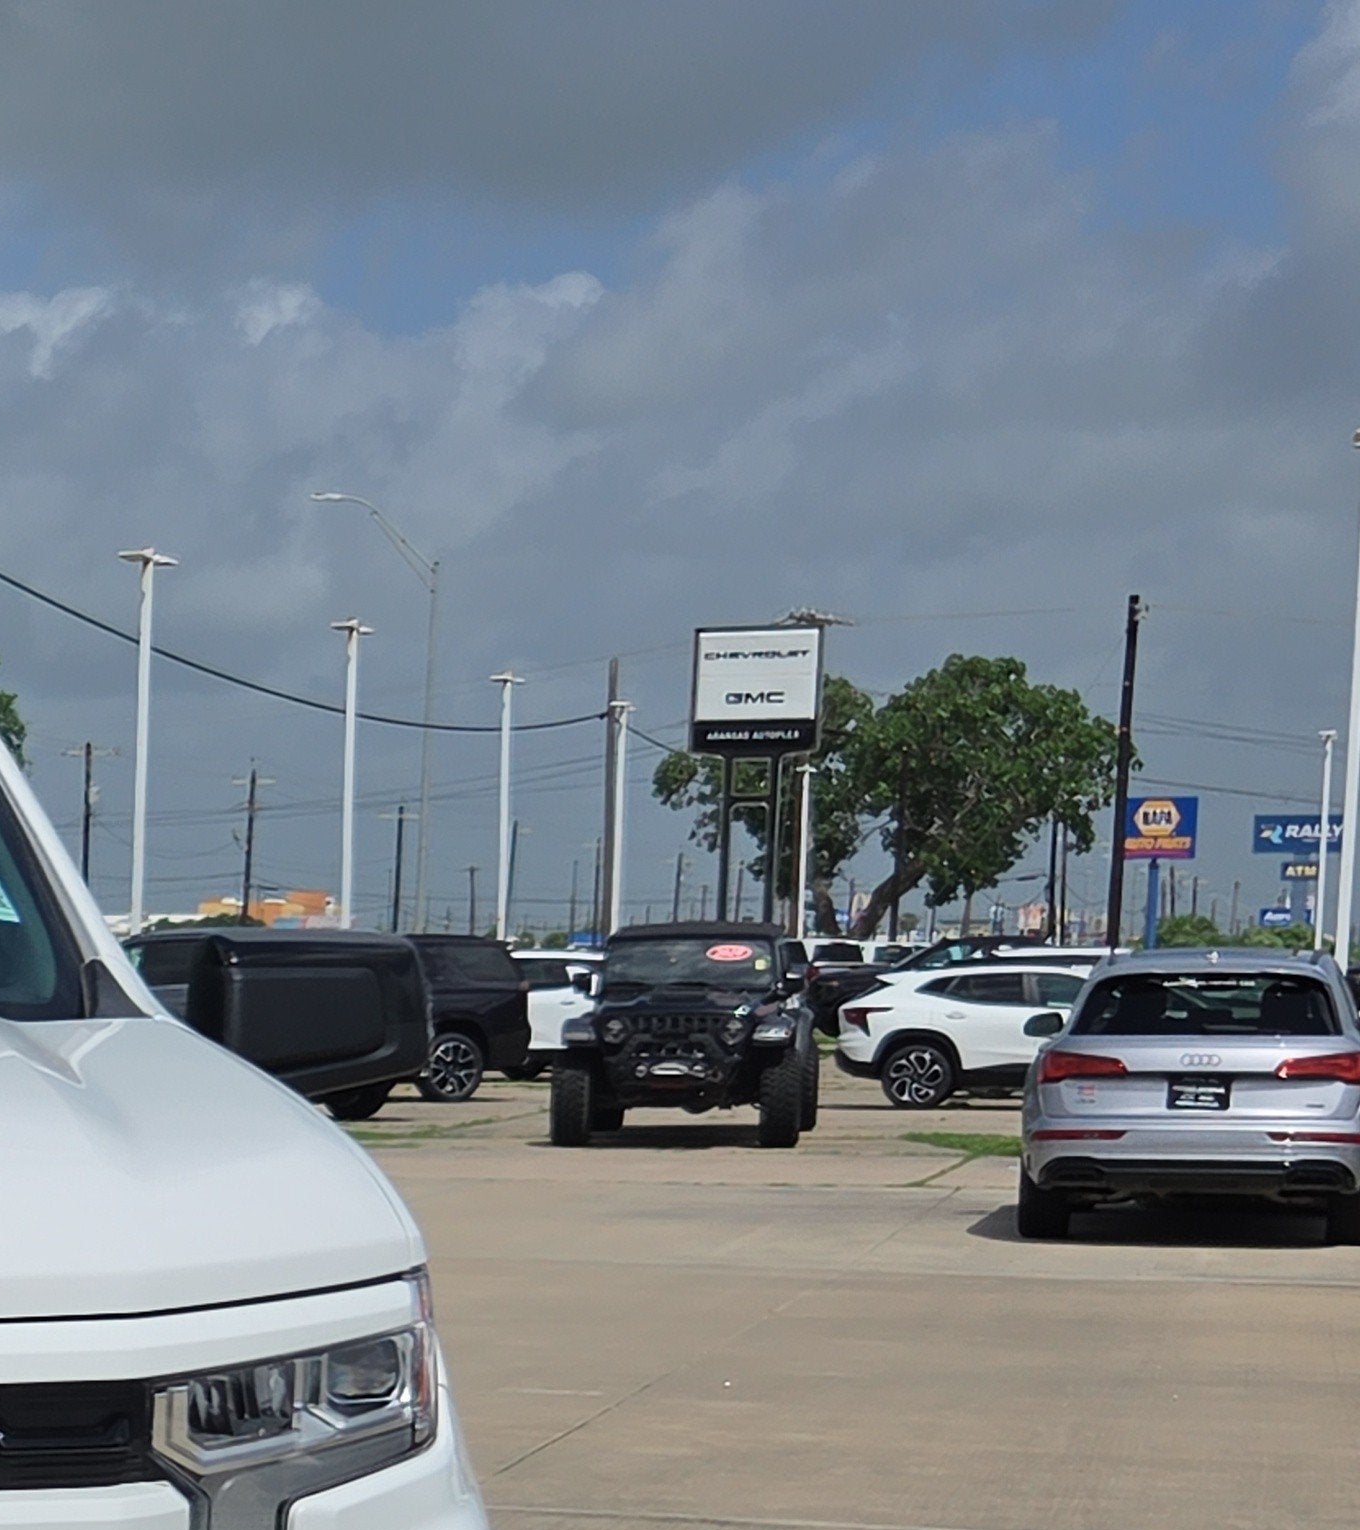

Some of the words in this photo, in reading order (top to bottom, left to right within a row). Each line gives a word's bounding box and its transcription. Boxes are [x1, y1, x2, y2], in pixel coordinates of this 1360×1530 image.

[704, 650, 810, 660] CHEVROLET
[725, 691, 785, 704] GMC
[1285, 865, 1318, 877] ATM
